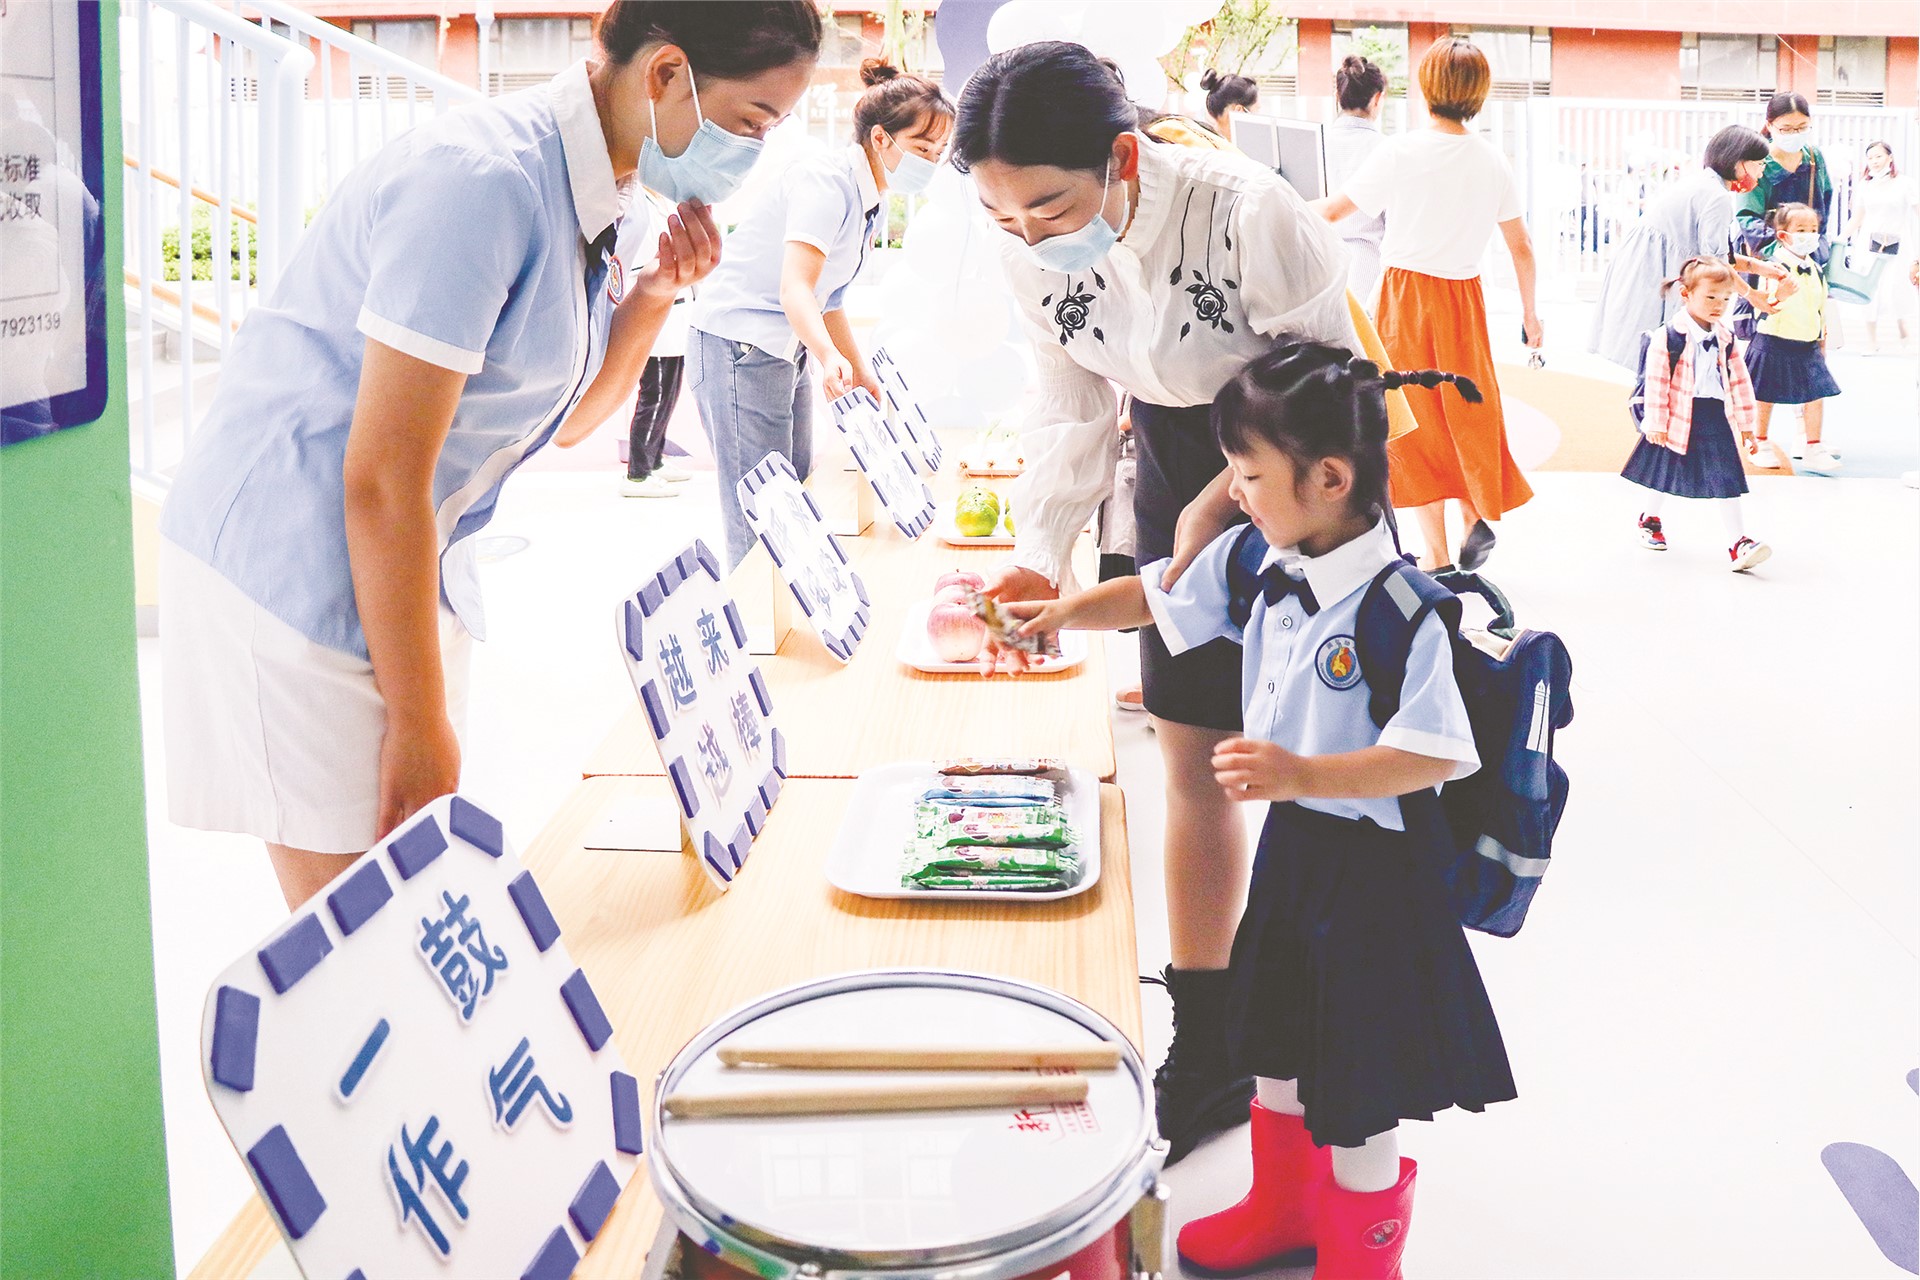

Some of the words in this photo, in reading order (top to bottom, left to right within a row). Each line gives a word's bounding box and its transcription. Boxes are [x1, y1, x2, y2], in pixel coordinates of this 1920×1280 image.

[658, 608, 730, 711] 越来
[698, 690, 763, 798] 越棒
[338, 889, 509, 1098] 一鼓
[386, 1036, 573, 1257] 作气
